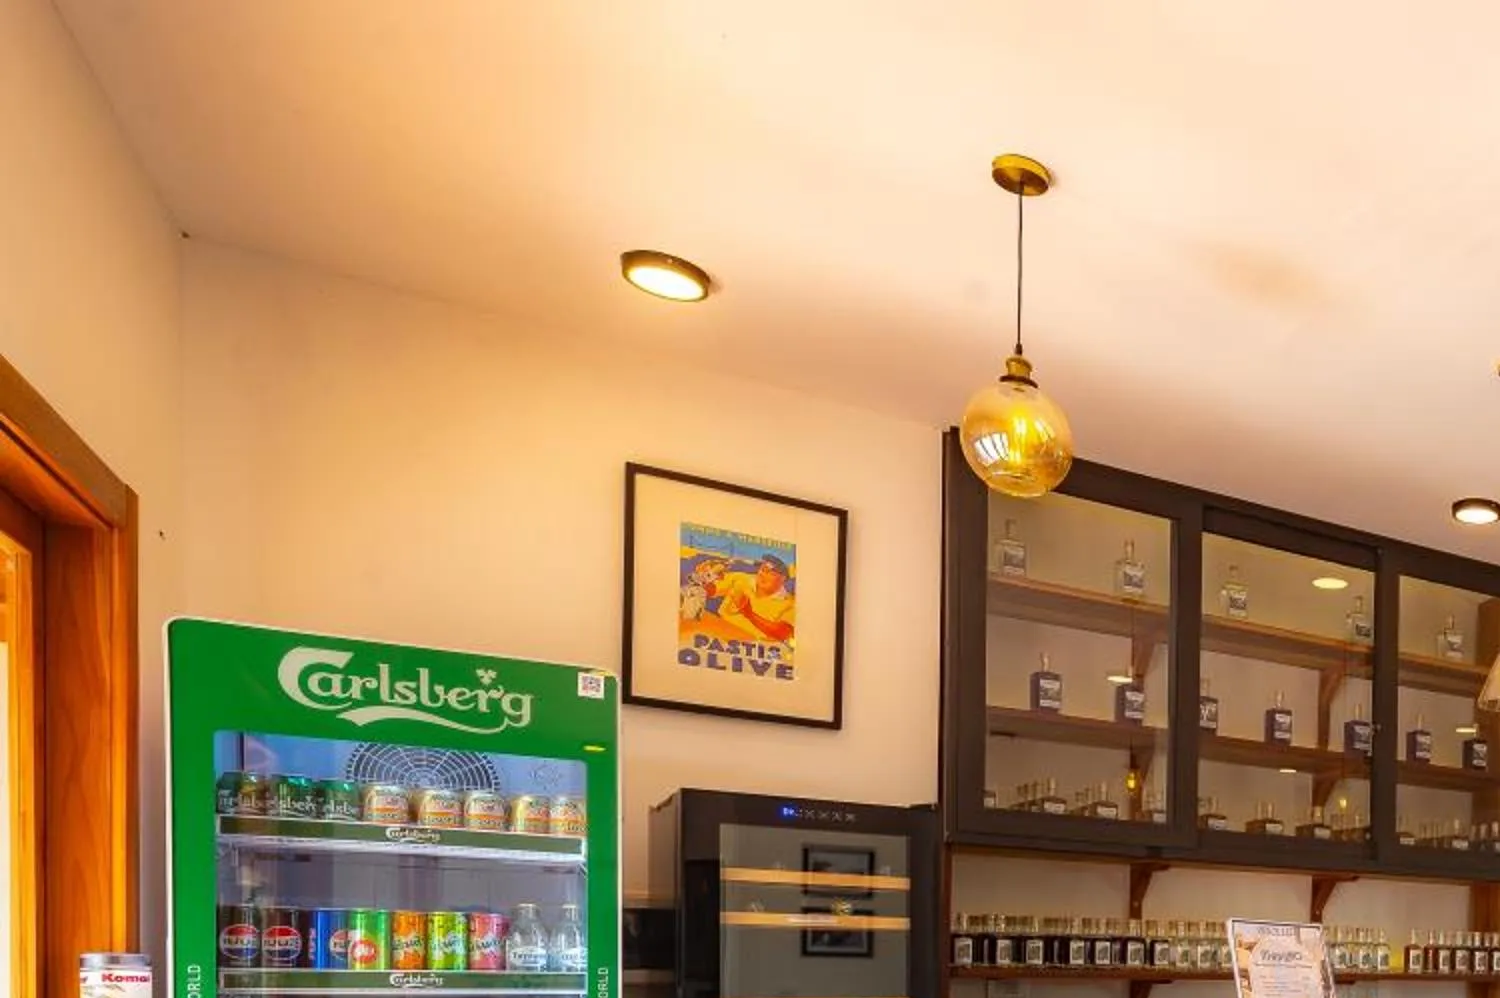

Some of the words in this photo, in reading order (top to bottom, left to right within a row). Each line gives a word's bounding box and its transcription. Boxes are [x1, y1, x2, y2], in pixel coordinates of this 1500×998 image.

[694, 634, 782, 660] PASTIS
[678, 648, 795, 681] OLIVE
[277, 646, 535, 735] Carlsberg
[386, 827, 441, 844] Carlsberg
[389, 973, 444, 988] Carlsberg
